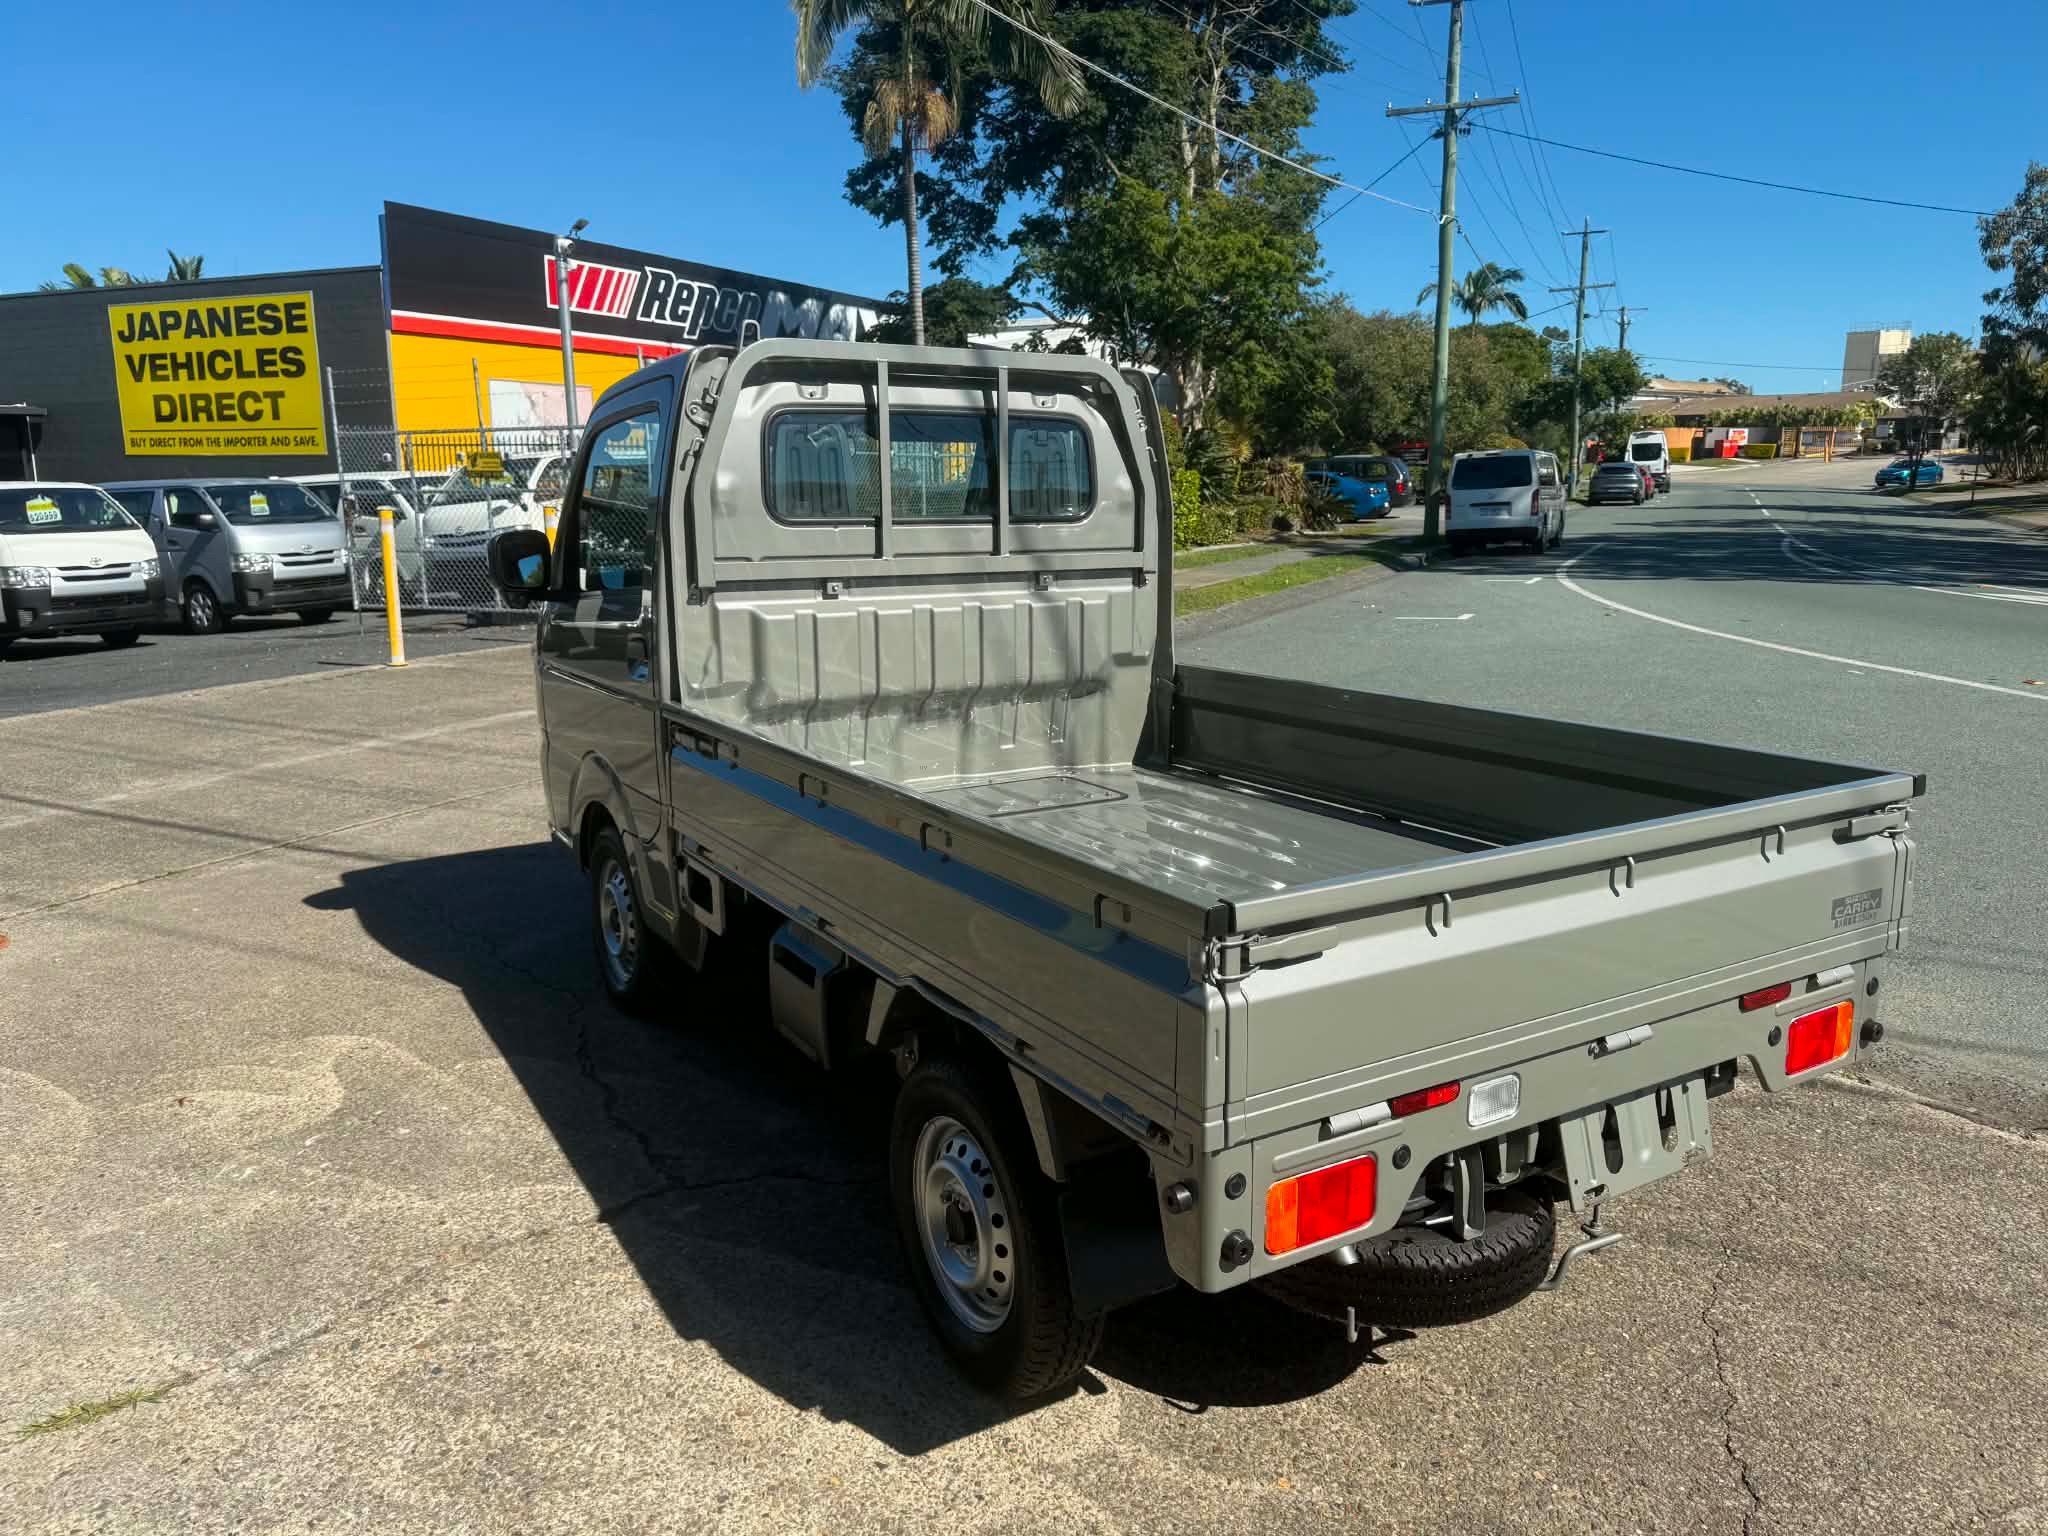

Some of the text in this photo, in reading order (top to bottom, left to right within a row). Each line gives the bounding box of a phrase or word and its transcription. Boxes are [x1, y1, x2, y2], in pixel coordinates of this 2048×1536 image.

[637, 266, 762, 339] Repco
[117, 301, 308, 343] JAPANESE
[125, 346, 306, 383] VEHICLES
[152, 390, 286, 423] DIRECT
[130, 435, 319, 448] BUY DIRECT FROM THE IMPORTER AND SAVE.
[1834, 897, 1880, 918] CARRY
